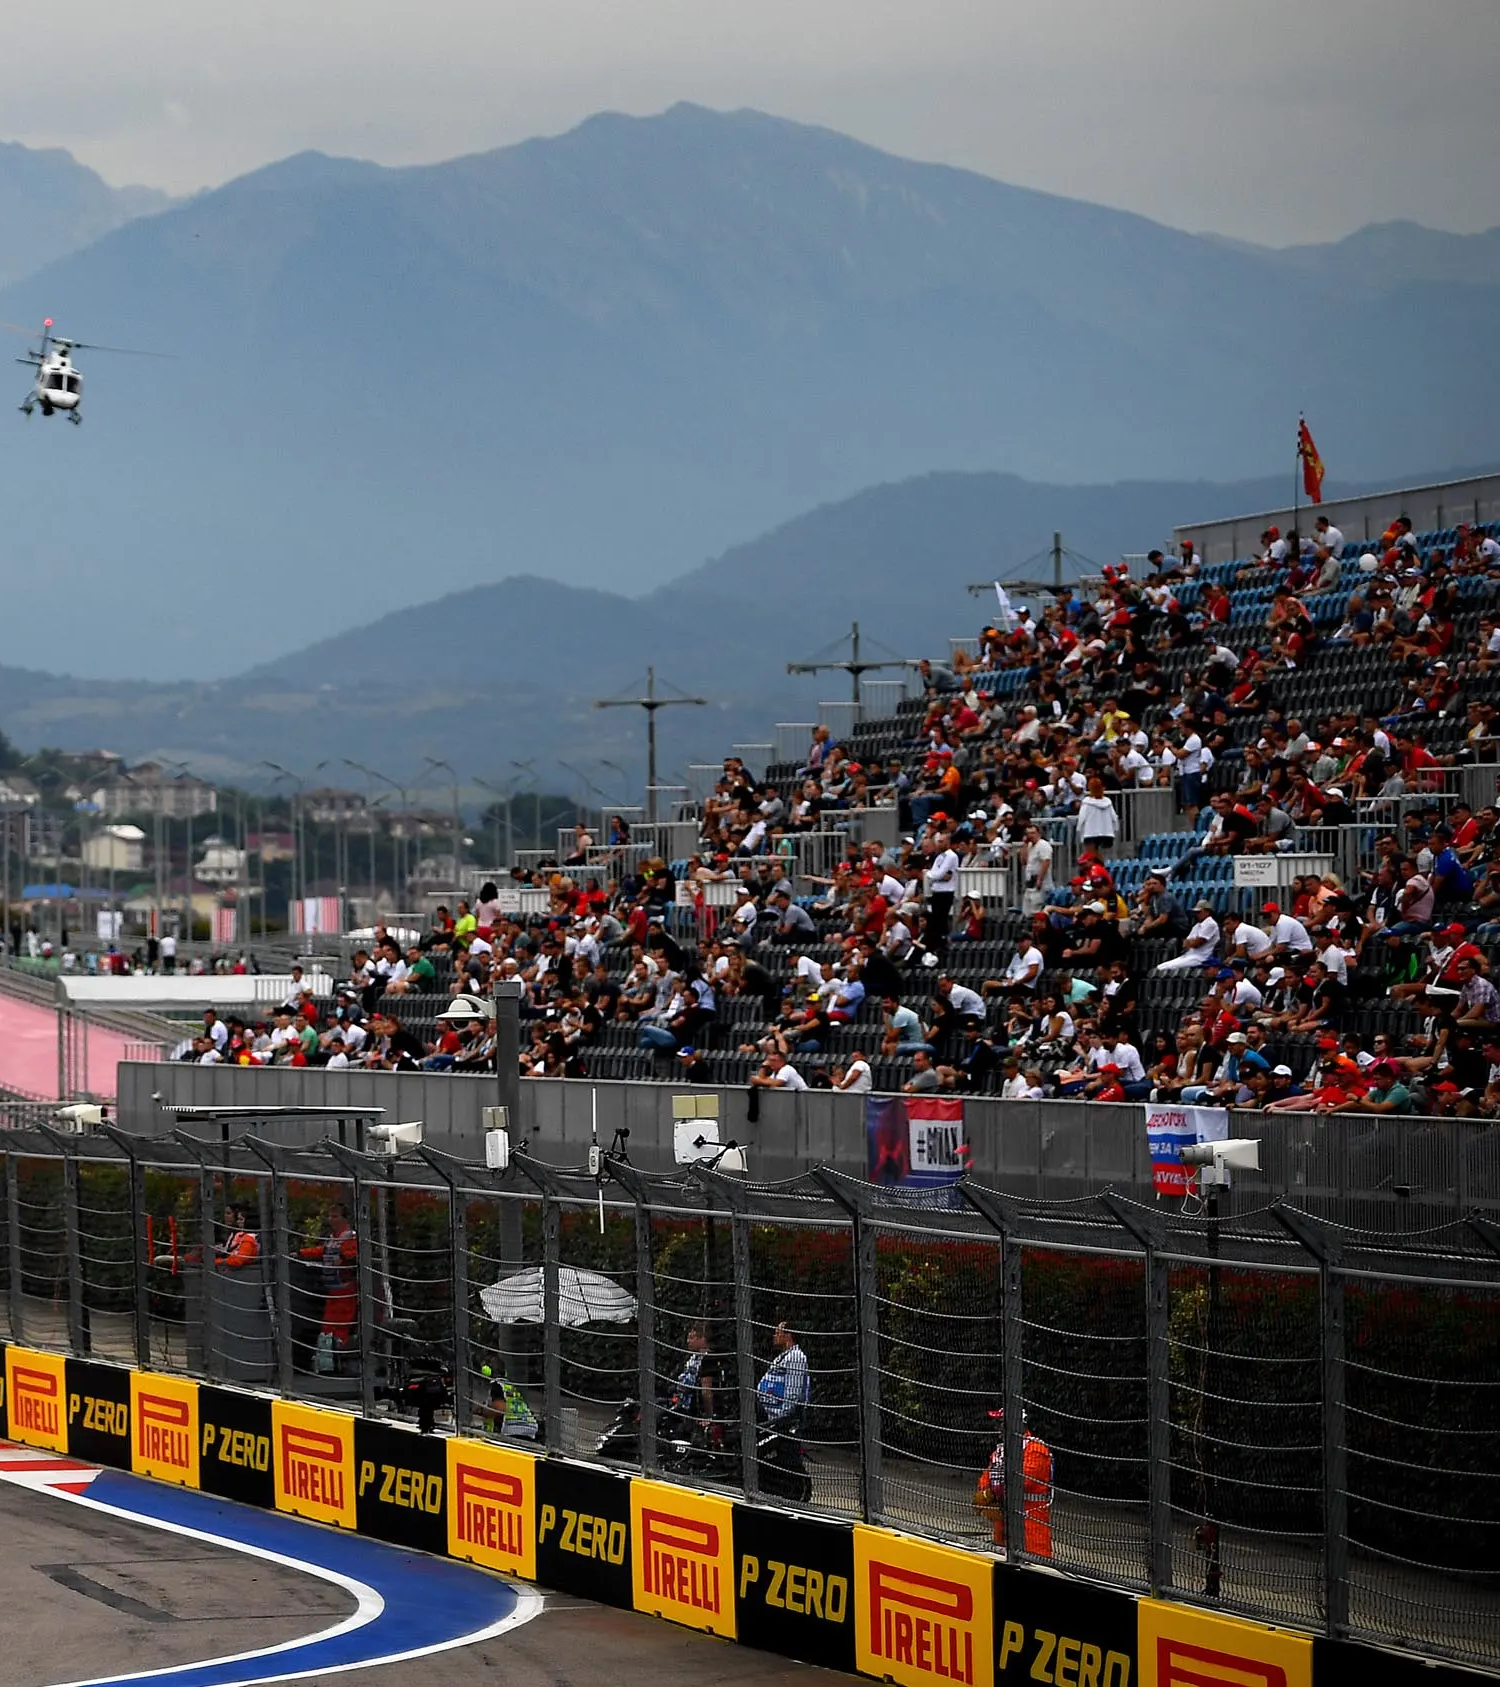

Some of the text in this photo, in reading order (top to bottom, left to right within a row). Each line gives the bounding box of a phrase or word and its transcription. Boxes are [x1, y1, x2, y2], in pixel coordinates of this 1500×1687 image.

[12, 1366, 58, 1435] PIRELLI
[69, 1394, 128, 1436] P ZERO
[138, 1392, 189, 1468] PIRELLI
[202, 1424, 269, 1471] P ZERO
[282, 1424, 344, 1510] PIRELLI
[359, 1461, 442, 1514] P ZERO
[456, 1463, 523, 1556] PIRELLI
[539, 1504, 626, 1565] P ZERO
[642, 1508, 720, 1612] PIRELLI
[740, 1555, 847, 1622] P ZERO
[869, 1560, 973, 1686] PIRELLI
[1000, 1621, 1023, 1669] P
[1031, 1630, 1129, 1687] ZERO
